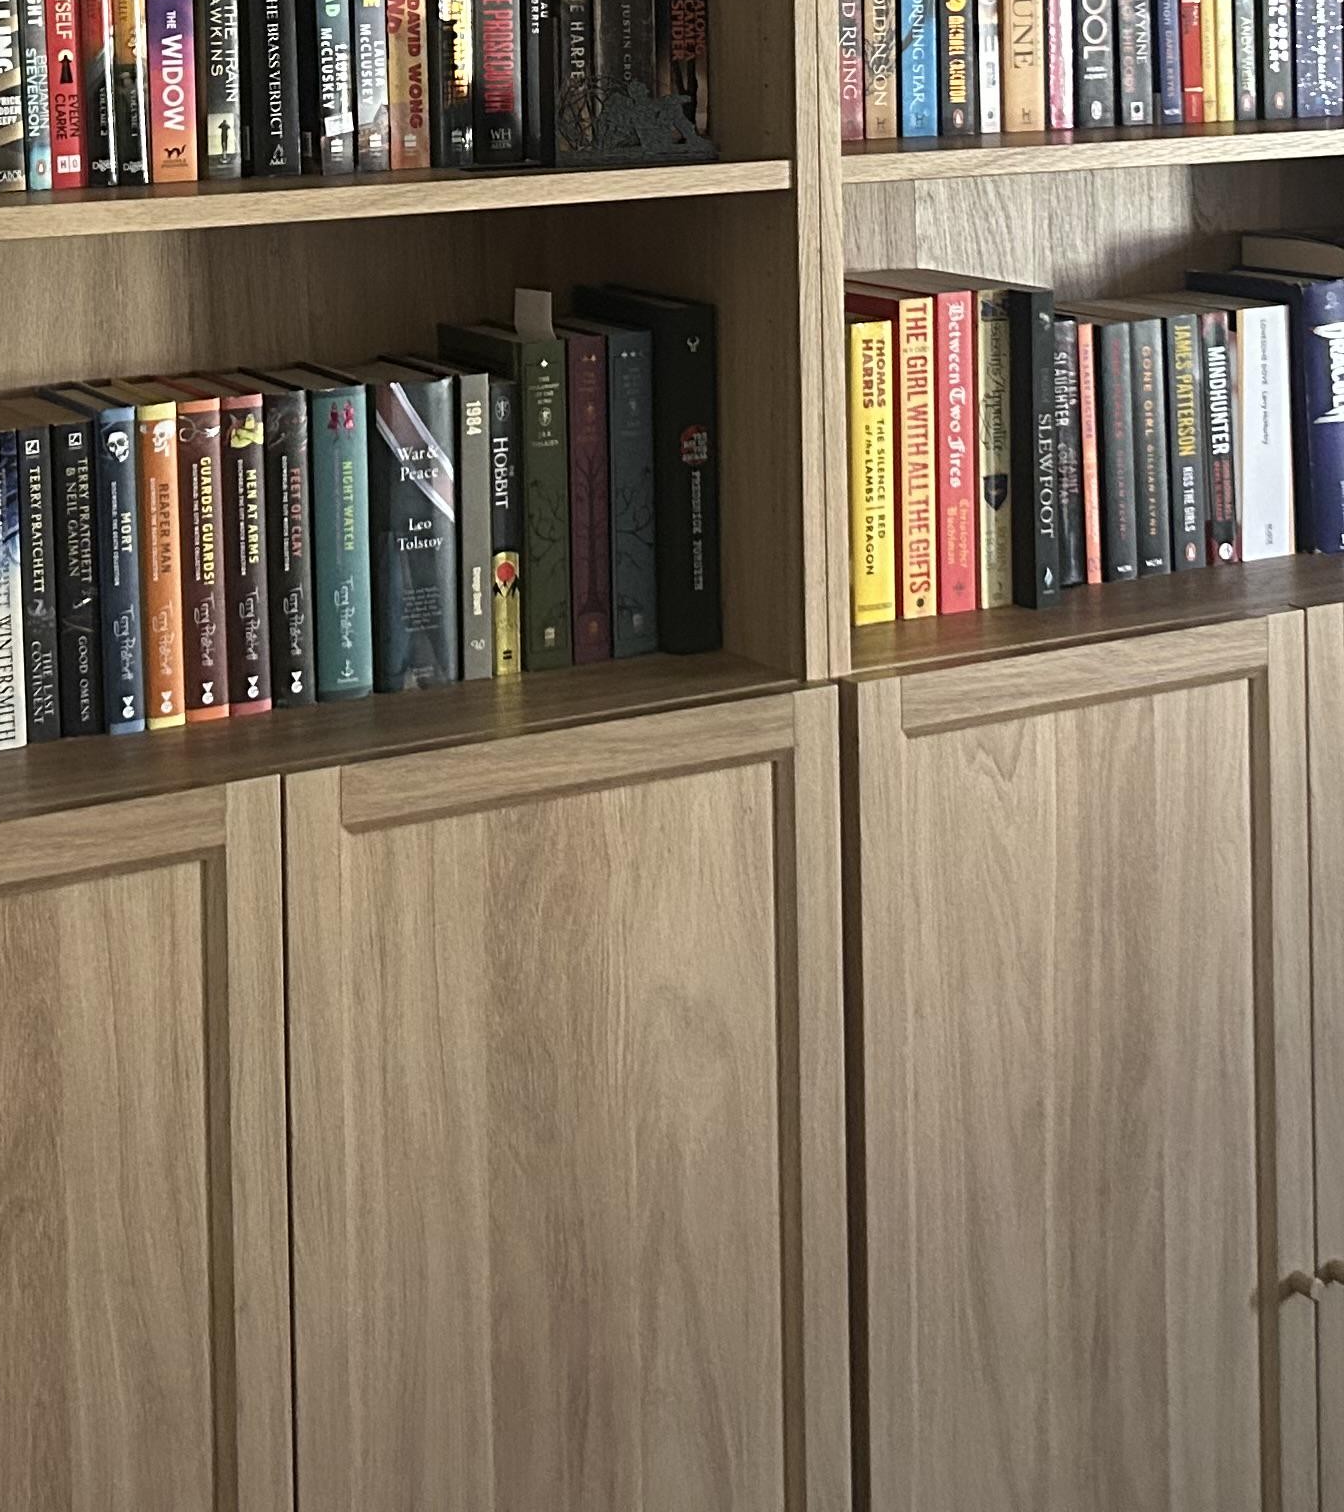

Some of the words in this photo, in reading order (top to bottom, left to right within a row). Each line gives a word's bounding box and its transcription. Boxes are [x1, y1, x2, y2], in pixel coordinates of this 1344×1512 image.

[840, 27, 857, 99] RISING
[25, 49, 38, 137] STEVENSON
[876, 339, 886, 407] THOMAS
[1175, 325, 1191, 371] JAMES
[862, 339, 873, 408] HARRIS
[466, 401, 482, 435] 1984
[1175, 373, 1195, 457] PATTERSON
[1208, 347, 1229, 455] MINDHUNTER
[398, 446, 424, 461] War
[426, 446, 439, 460] &
[400, 465, 439, 481] Peace
[493, 437, 508, 508] HOBBIT
[1039, 413, 1052, 537] SLEWFOOT
[29, 466, 41, 516] TERRY
[246, 470, 256, 493] MEN
[121, 512, 132, 552] MORT
[248, 500, 256, 515] AT
[408, 519, 431, 531] Leo
[31, 520, 44, 593] PRATCHETT
[248, 519, 258, 563] ARMS
[397, 535, 443, 552] Tolstoy
[865, 517, 874, 575] DRAGON
